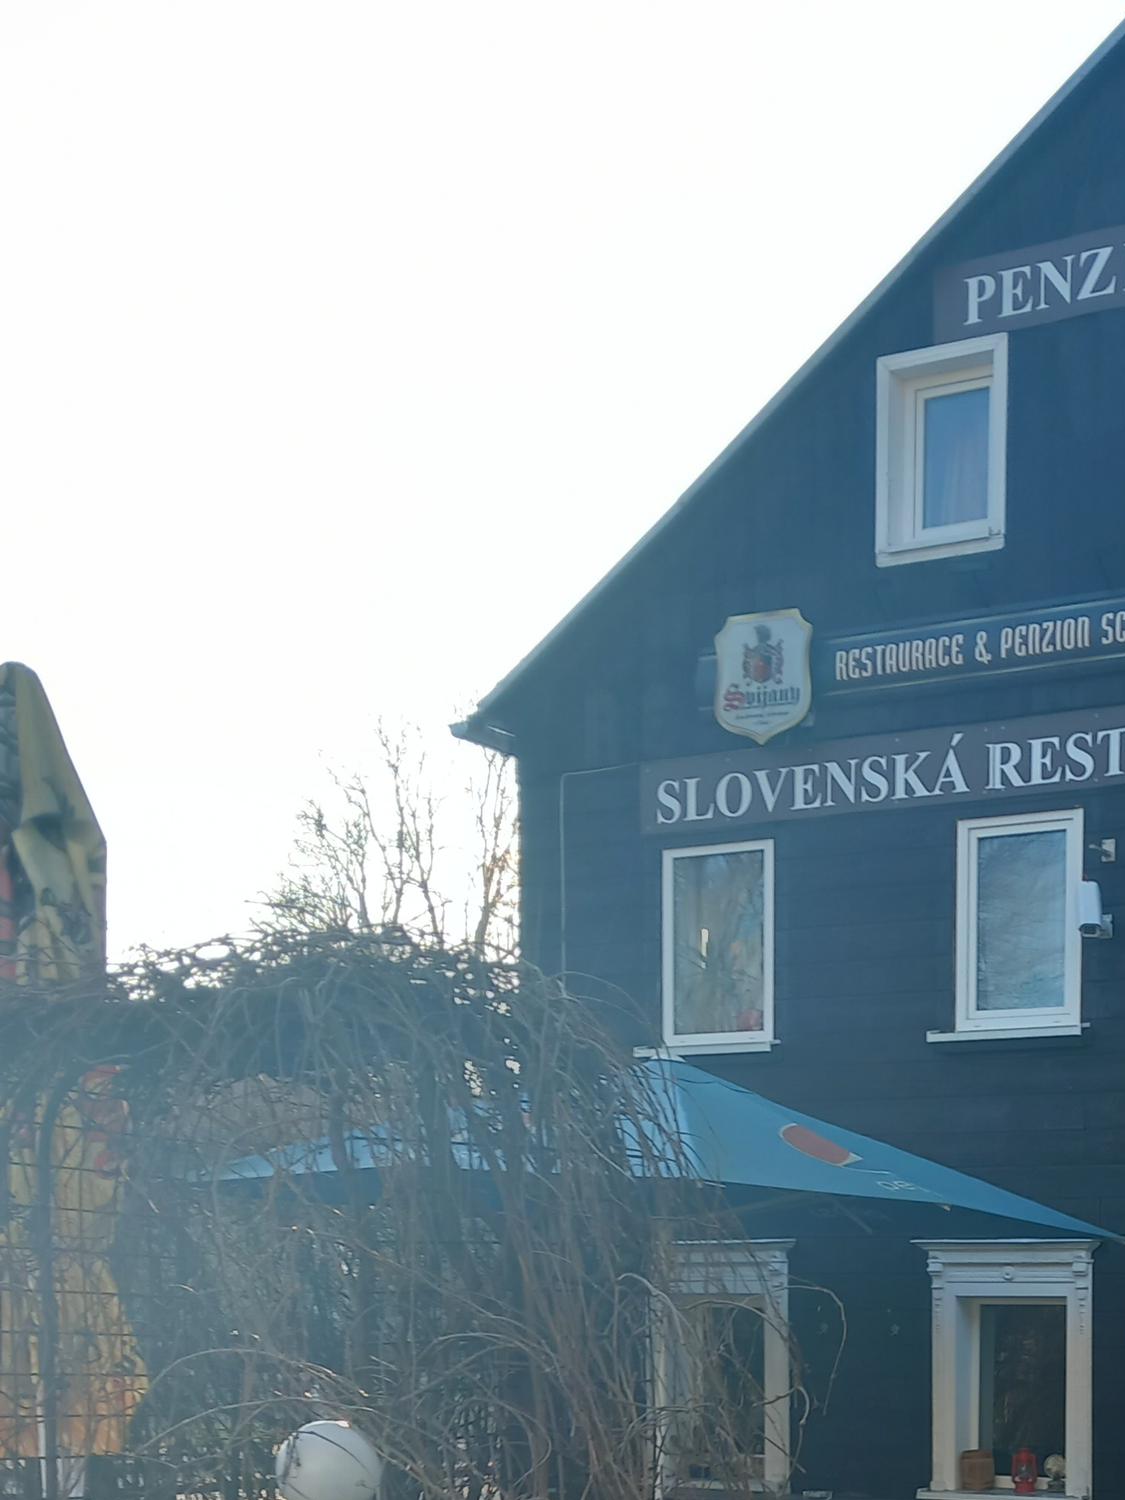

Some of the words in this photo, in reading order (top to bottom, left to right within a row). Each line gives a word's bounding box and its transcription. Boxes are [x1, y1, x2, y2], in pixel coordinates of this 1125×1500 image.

[834, 633, 965, 682] RESTAURACE
[974, 630, 992, 665] &
[1000, 615, 1091, 659] PENZION
[655, 732, 971, 826] SLOVENSKÁ
